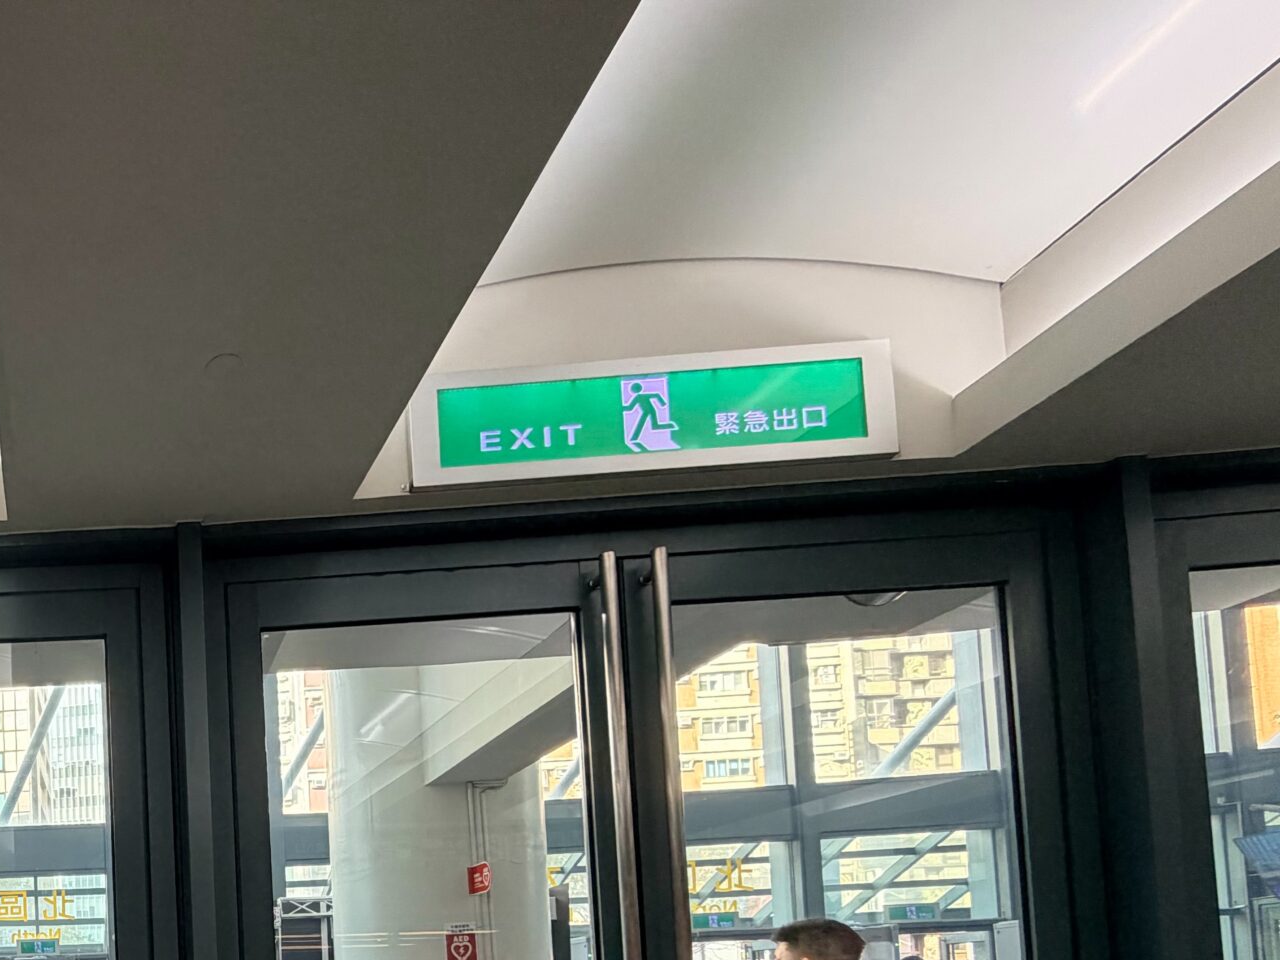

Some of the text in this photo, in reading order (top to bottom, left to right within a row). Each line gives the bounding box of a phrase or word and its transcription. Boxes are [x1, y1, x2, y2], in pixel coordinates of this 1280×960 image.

[715, 405, 828, 436] 緊急出口
[480, 424, 582, 452] EXIT
[453, 935, 469, 943] AED
